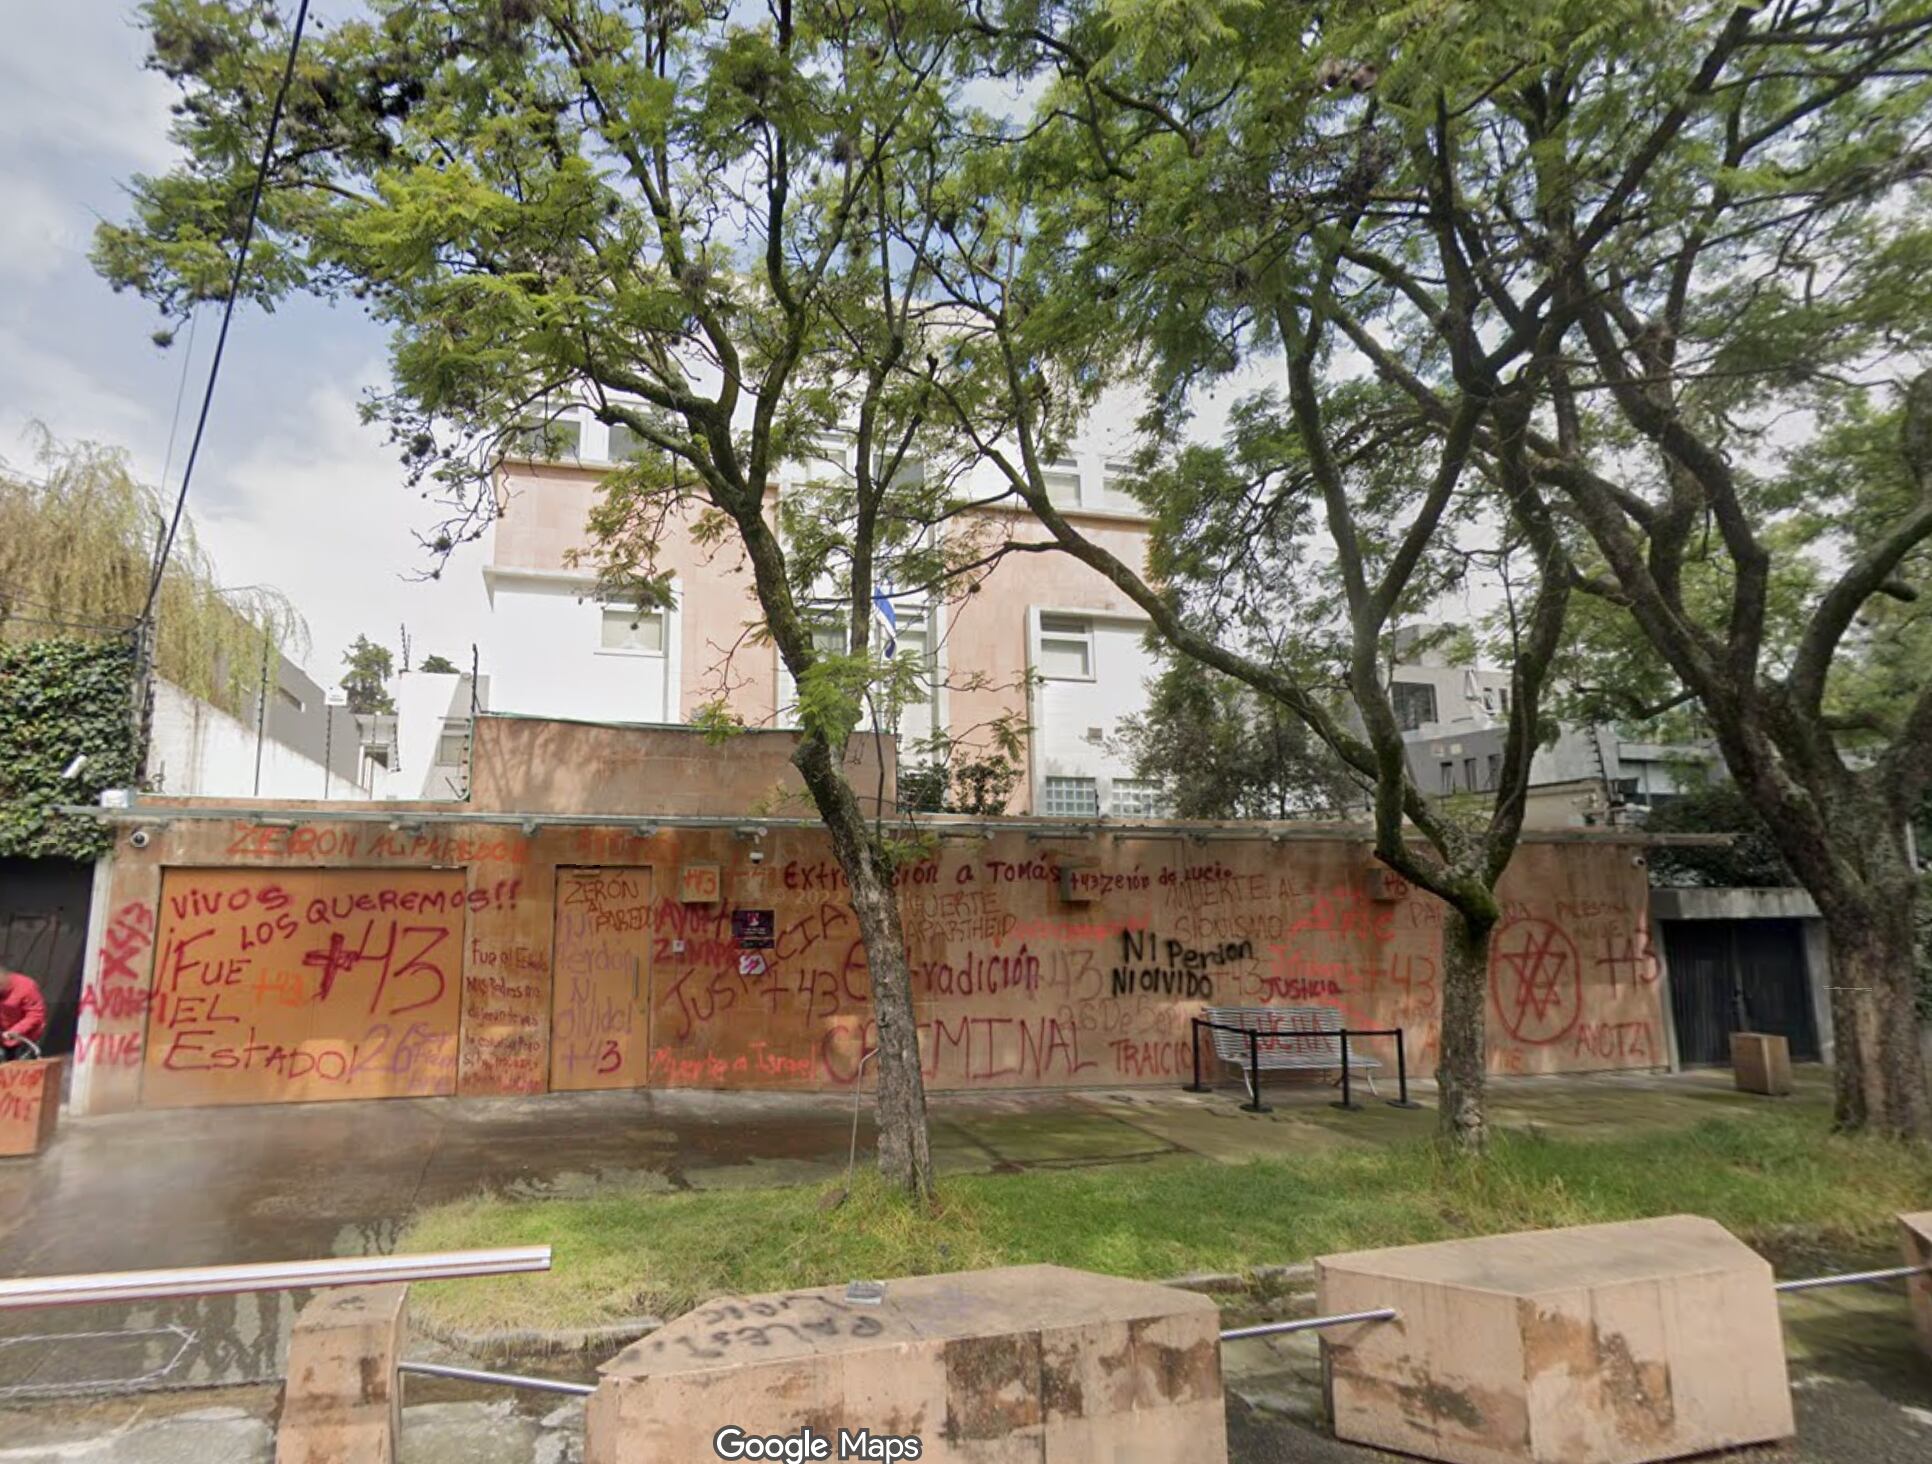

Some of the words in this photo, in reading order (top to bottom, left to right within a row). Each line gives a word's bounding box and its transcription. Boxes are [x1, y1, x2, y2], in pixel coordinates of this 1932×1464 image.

[564, 870, 640, 905] ZERÓN
[955, 863, 975, 885] a
[241, 913, 298, 951] LOS
[1121, 927, 1157, 964] NI
[302, 918, 451, 1017] +43
[1112, 966, 1135, 999] NI
[169, 994, 241, 1030] EL
